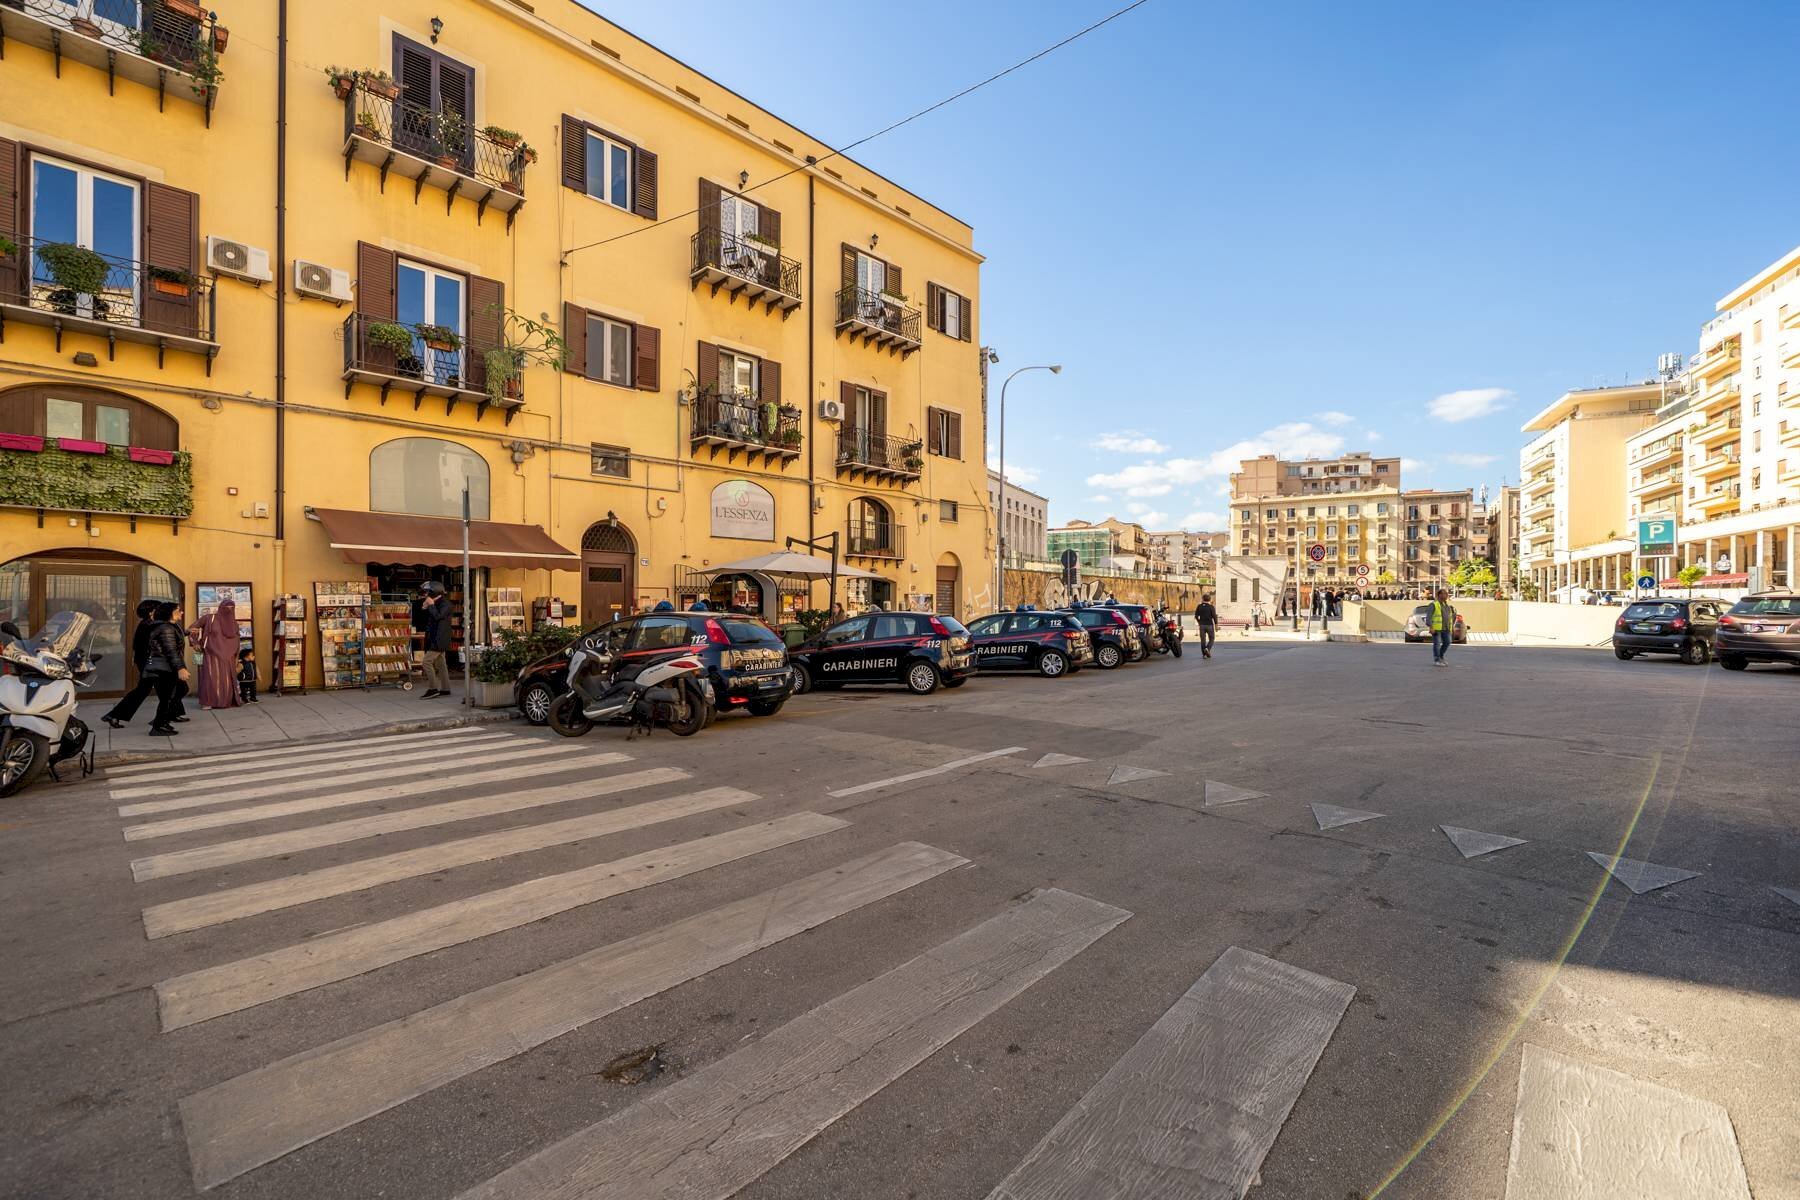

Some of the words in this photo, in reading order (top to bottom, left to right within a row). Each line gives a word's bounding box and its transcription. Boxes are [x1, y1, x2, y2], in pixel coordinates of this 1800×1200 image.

[715, 506, 768, 521] L'ESSENZA
[1649, 525, 1665, 539] P
[1360, 566, 1366, 574] 5
[1050, 619, 1062, 627] 112
[691, 634, 708, 644] 112
[926, 640, 941, 648] 112
[977, 645, 1028, 655] RABINIERI
[745, 660, 784, 672] CARABINIERI
[823, 657, 898, 672] CARABINIERI
